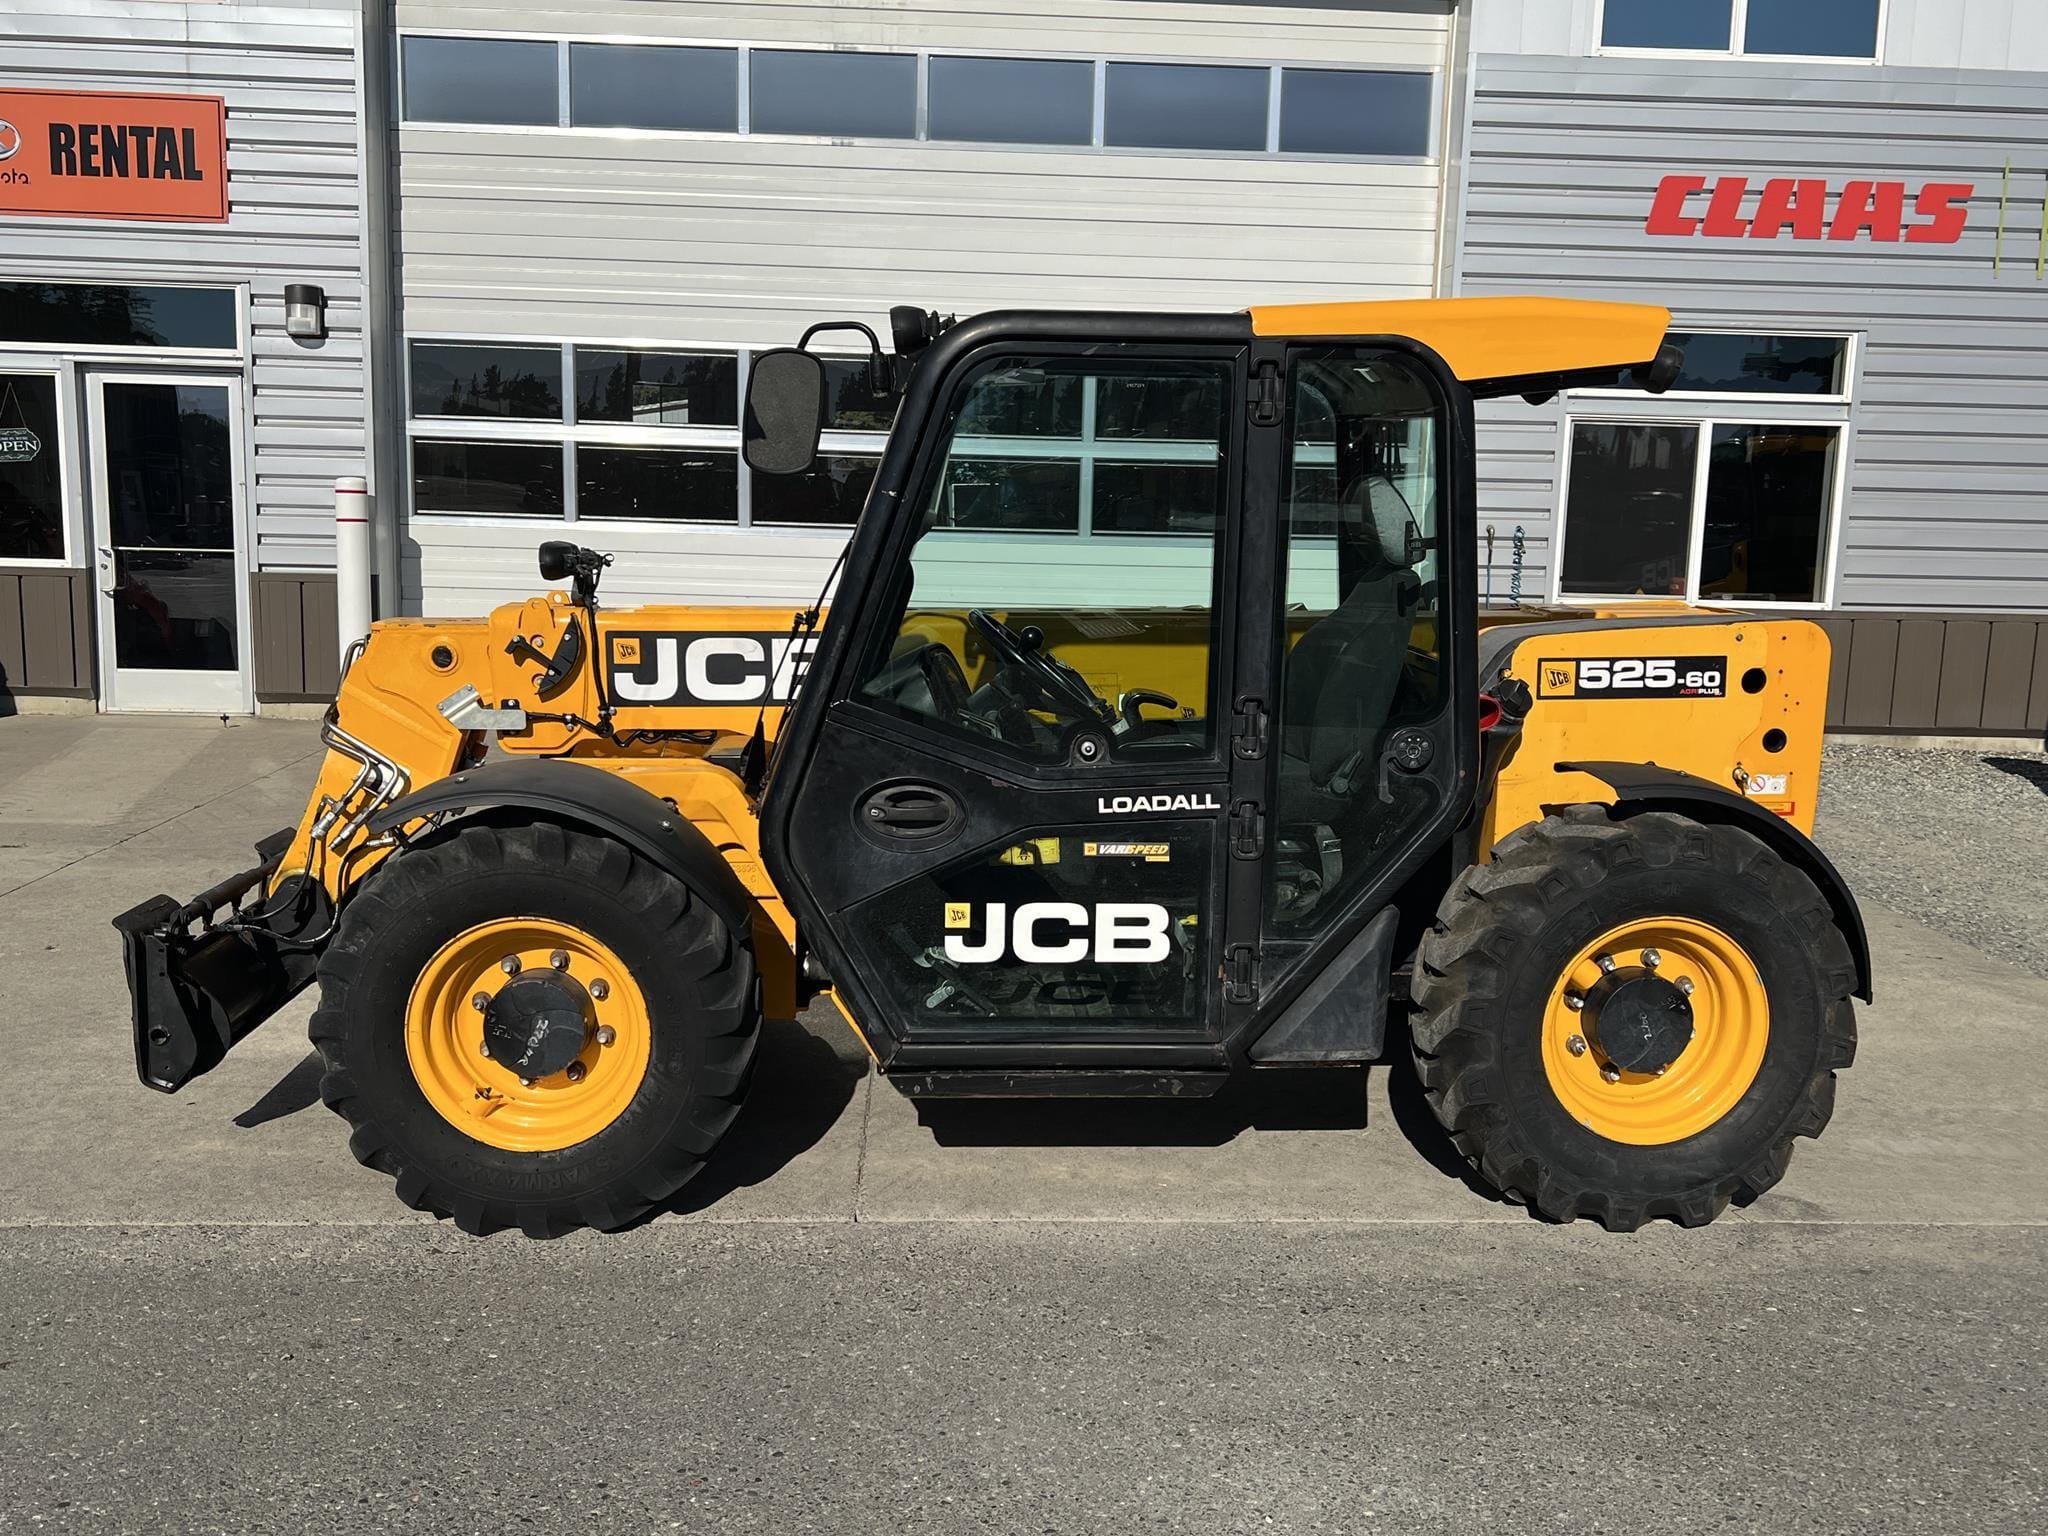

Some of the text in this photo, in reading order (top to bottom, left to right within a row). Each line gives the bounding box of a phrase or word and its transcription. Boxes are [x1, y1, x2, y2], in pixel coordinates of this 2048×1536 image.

[48, 122, 203, 181] RENTAL
[1645, 175, 1975, 243] CLAAS
[0, 440, 37, 451] PEN
[1549, 670, 1570, 687] JCB
[1578, 659, 1721, 689] 525-60
[1098, 793, 1221, 814] LOADALL
[951, 909, 967, 922] JCB
[944, 902, 1171, 963] JCB
